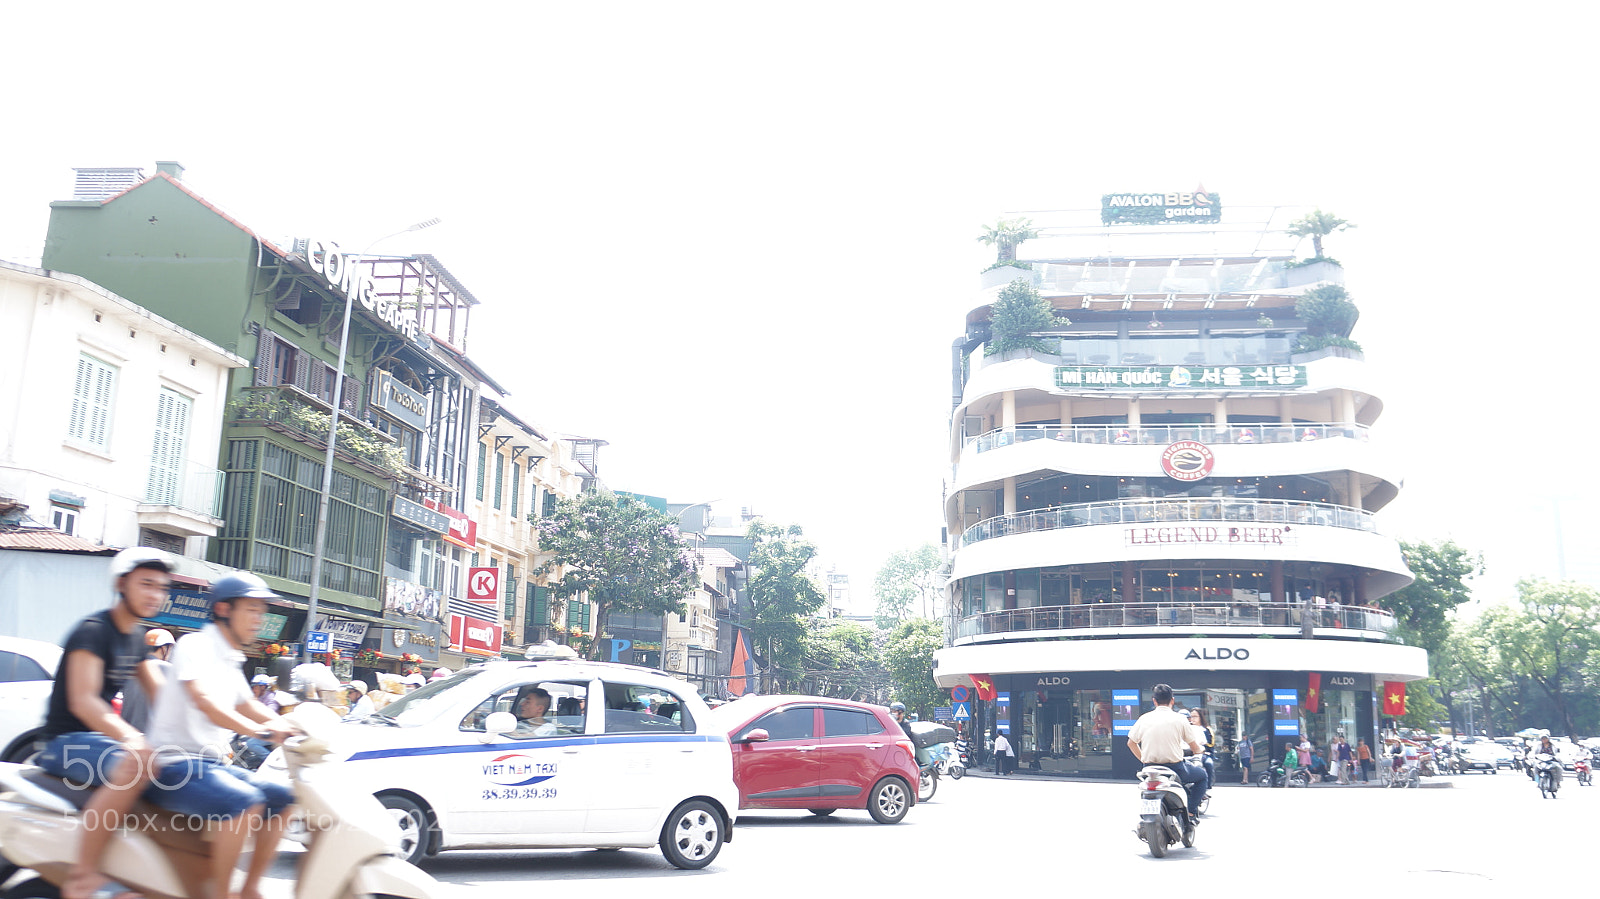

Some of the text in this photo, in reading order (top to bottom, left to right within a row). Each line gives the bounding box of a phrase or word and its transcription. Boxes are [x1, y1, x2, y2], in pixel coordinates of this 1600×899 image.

[1109, 195, 1162, 206] AVALON
[1164, 207, 1211, 218] garden
[1062, 366, 1162, 385] MÌ HÀN QUỐC
[1199, 366, 1299, 386] 서울 식당
[1163, 442, 1212, 460] HIGHLANDS
[1170, 469, 1208, 479] COFFEE
[1130, 527, 1284, 545] LEGEND BEER
[477, 576, 493, 592] K
[346, 622, 366, 635] TOURS
[610, 639, 631, 662] P
[1184, 648, 1250, 660] ALDO
[1037, 676, 1071, 686] ALDO
[1329, 676, 1355, 686] ALDO
[482, 765, 504, 775] VIET
[535, 763, 558, 774] TAXI
[481, 787, 558, 800] 38.39.39.39
